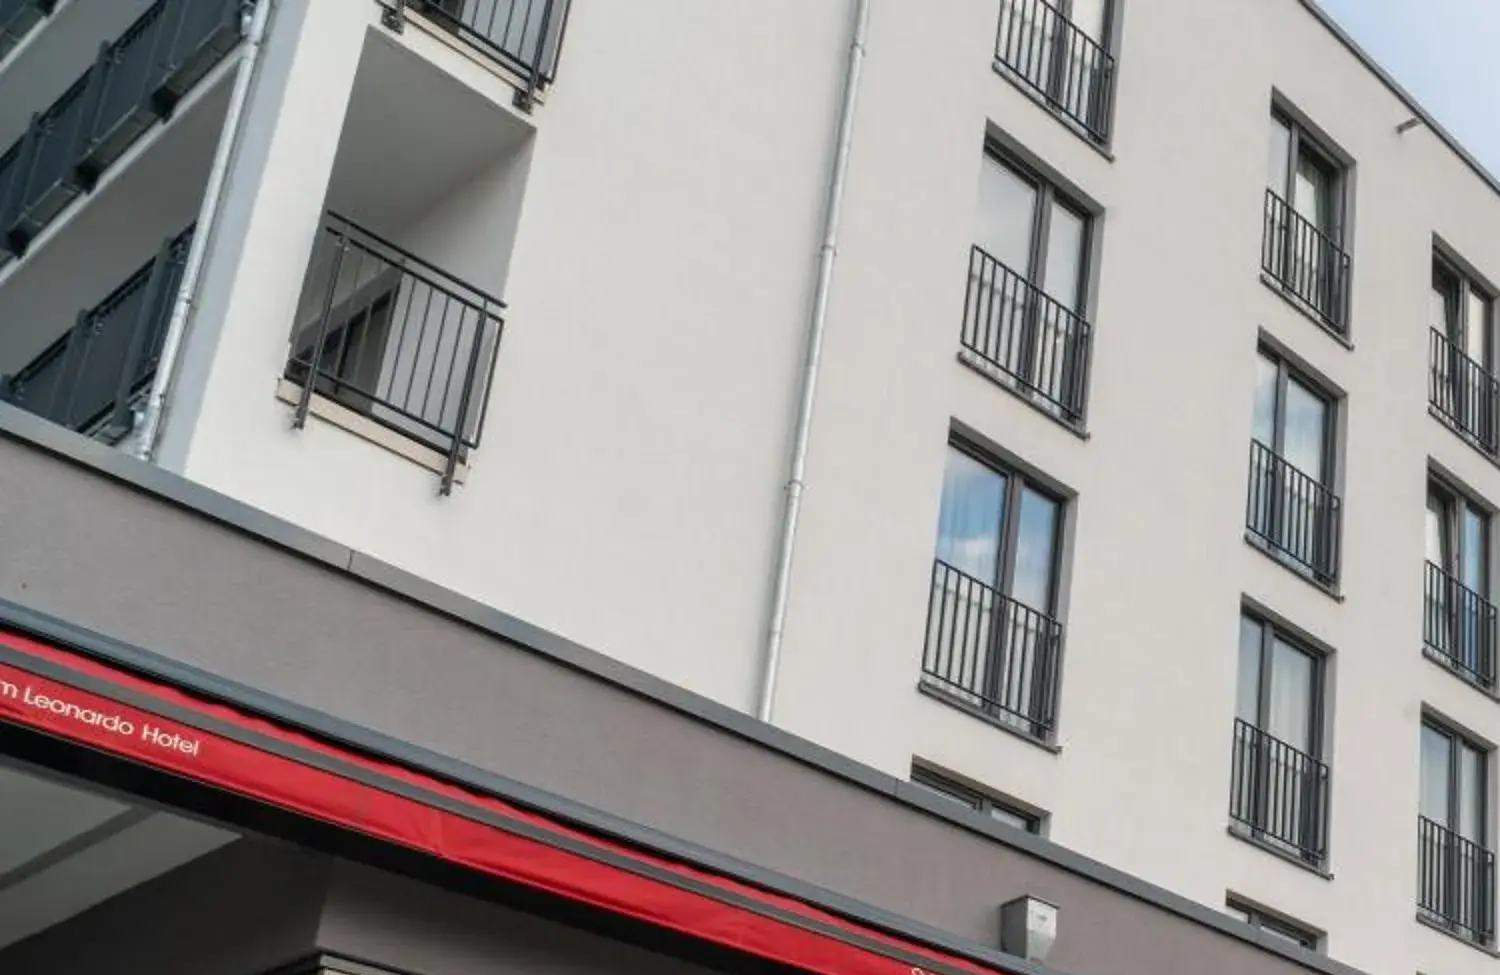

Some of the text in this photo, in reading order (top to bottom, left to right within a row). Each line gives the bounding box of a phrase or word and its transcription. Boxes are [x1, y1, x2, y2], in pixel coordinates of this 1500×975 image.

[0, 680, 200, 756] m Leonardo Hotel
